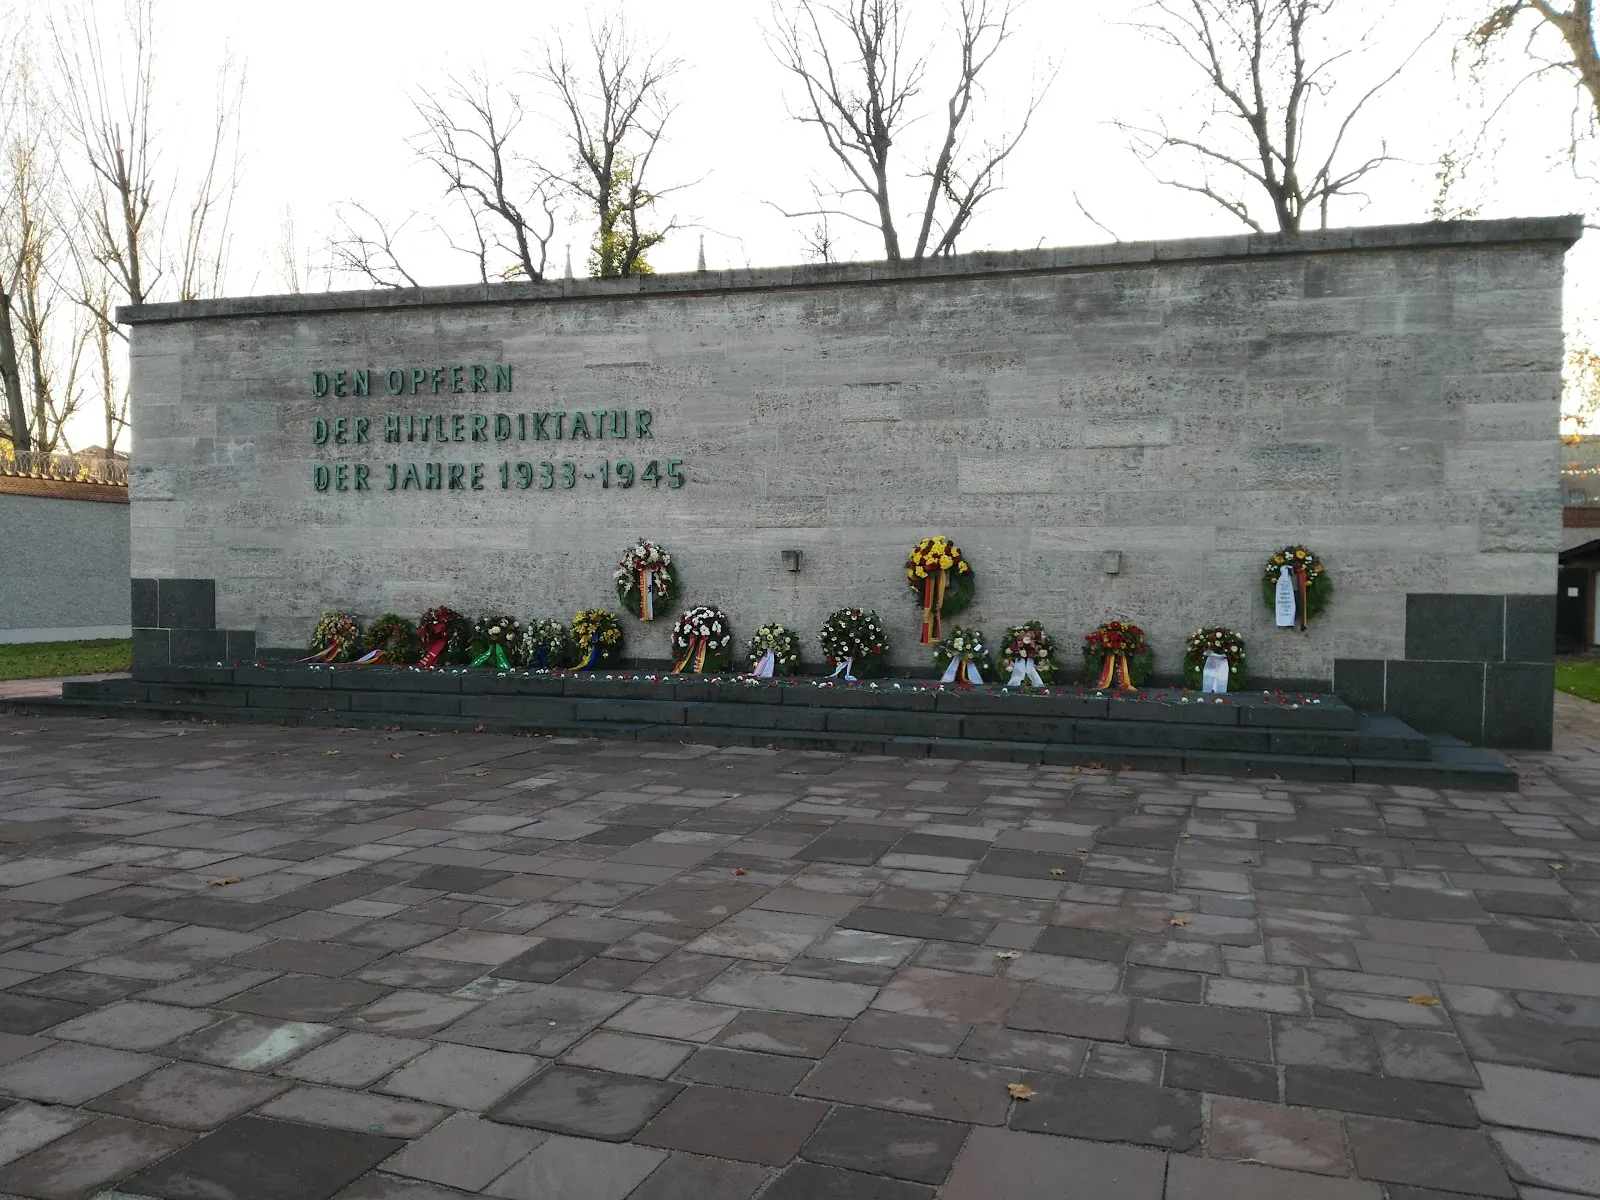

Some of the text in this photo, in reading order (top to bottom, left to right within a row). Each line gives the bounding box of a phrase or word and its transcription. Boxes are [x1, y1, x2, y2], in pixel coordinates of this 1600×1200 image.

[312, 363, 512, 397] DEN OPFERN
[312, 409, 653, 445] DER HITLERDIKTATUR
[313, 458, 685, 490] DER JAHRE 1933-1945
